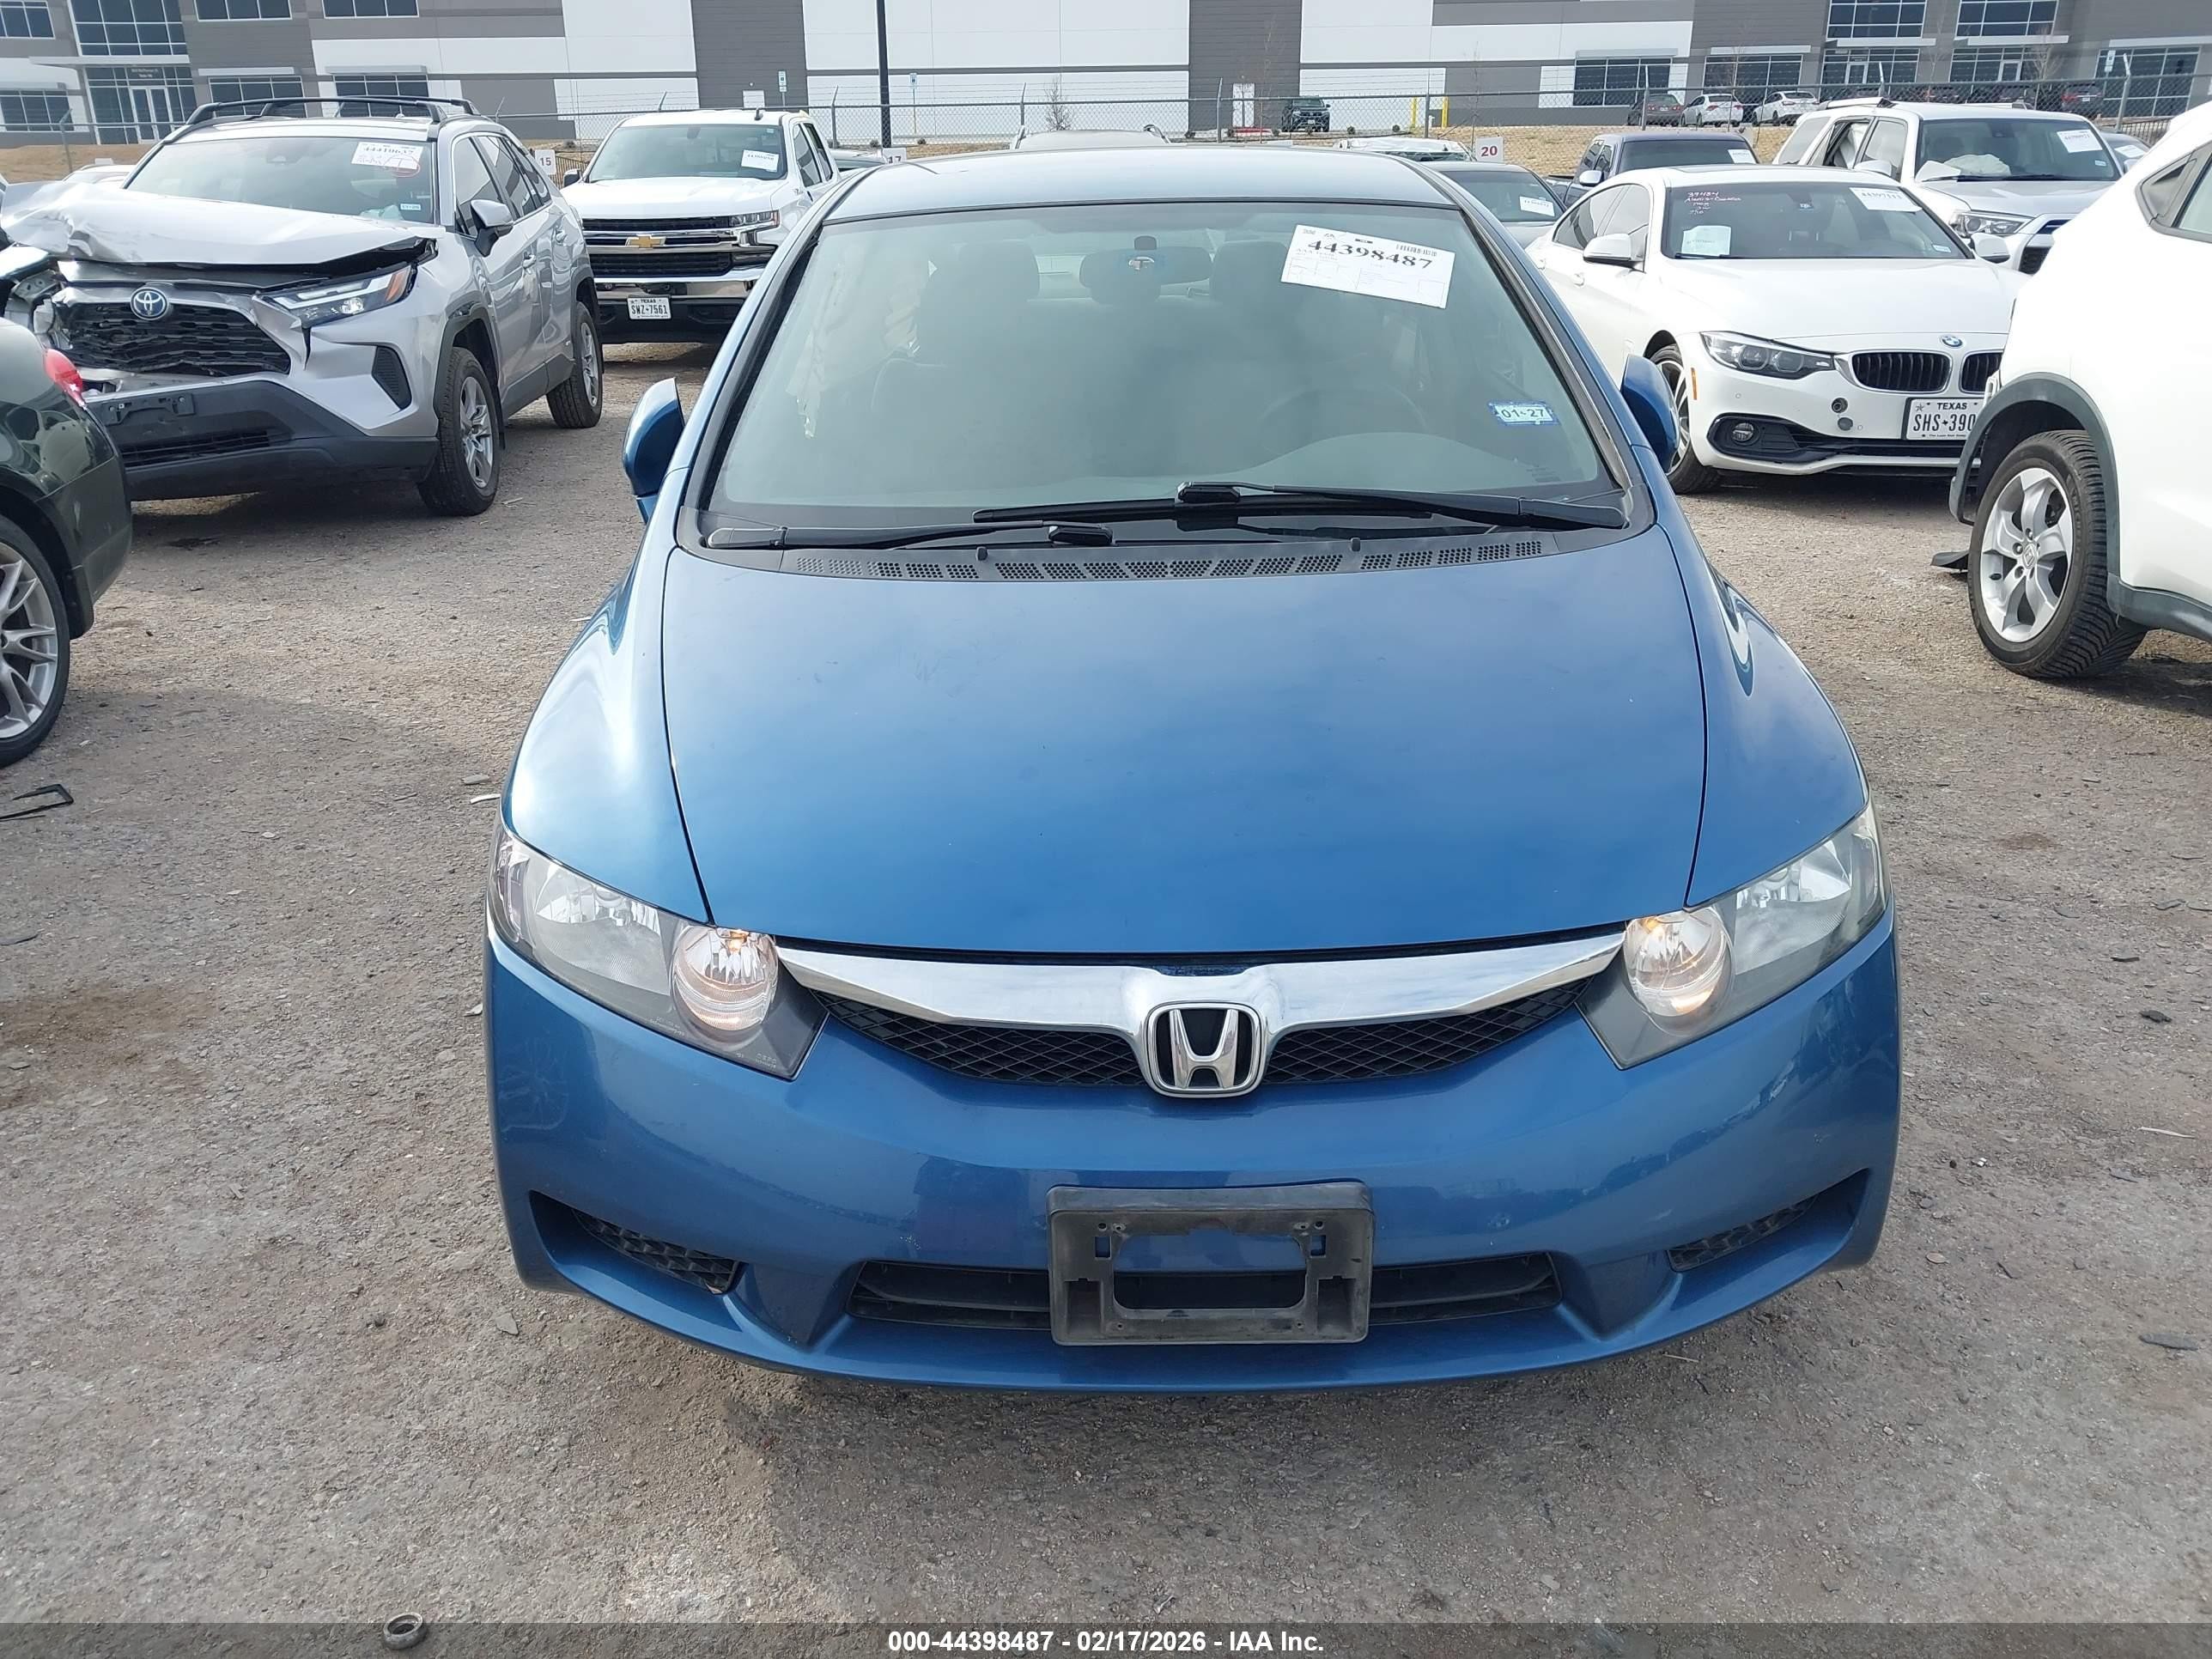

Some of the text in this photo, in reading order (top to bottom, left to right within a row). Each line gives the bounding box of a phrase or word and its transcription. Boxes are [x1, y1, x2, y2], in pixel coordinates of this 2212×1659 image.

[1481, 146, 1498, 156] 20
[540, 157, 551, 166] 15
[1308, 240, 1432, 269] 44398487
[1937, 402, 1967, 410] TEXAS
